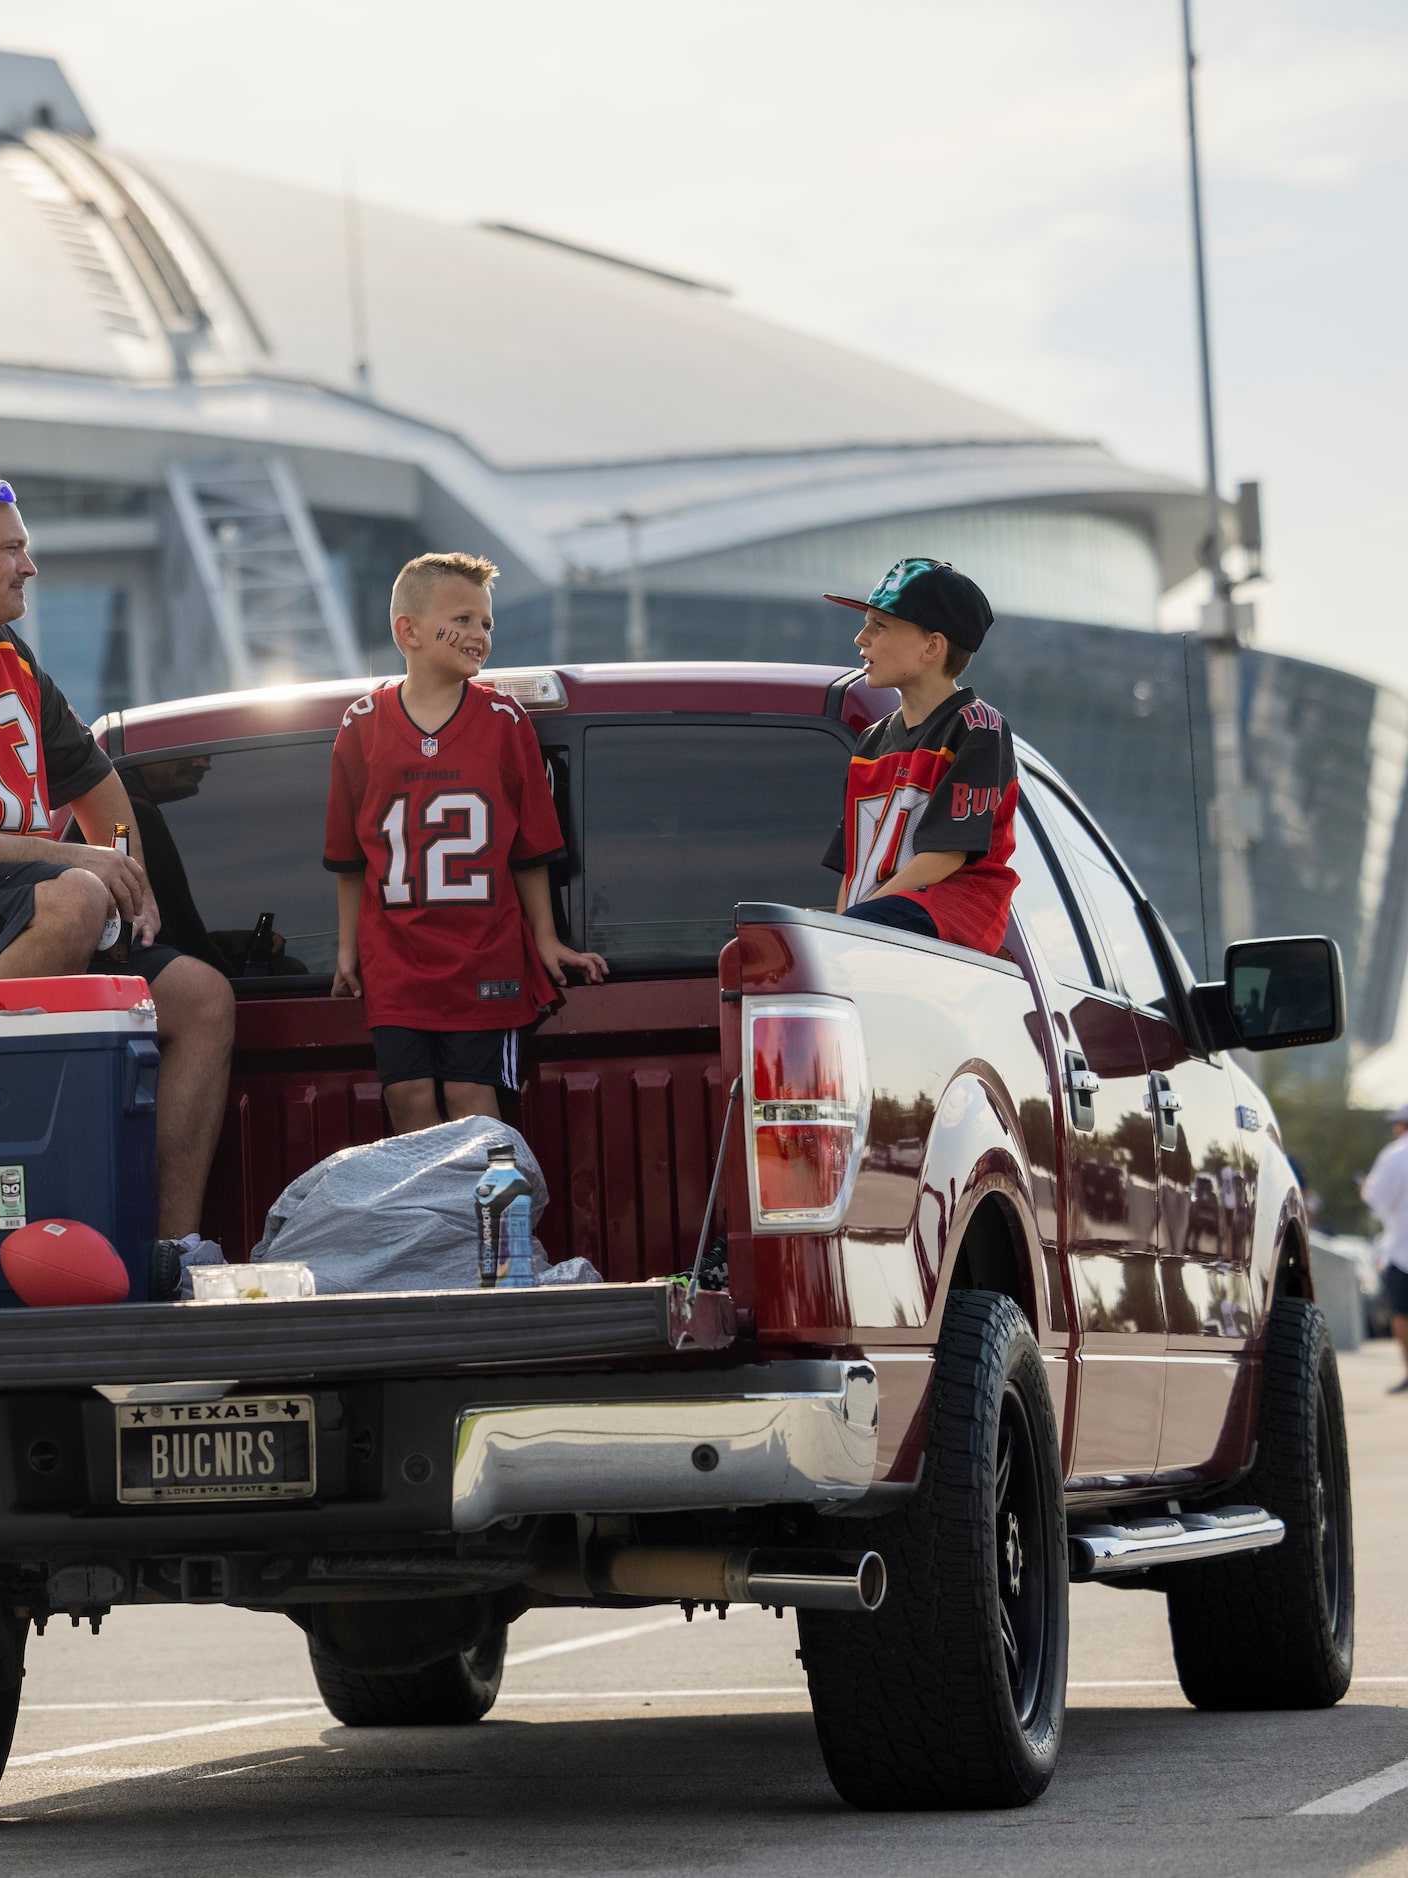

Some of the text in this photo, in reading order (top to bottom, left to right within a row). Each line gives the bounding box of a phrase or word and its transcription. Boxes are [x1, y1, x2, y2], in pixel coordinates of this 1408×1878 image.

[435, 627, 460, 648] #12
[378, 789, 495, 910] 12
[2, 1184, 20, 1194] 90
[170, 1404, 258, 1420] TEXAS
[152, 1430, 275, 1479] BUCNRS
